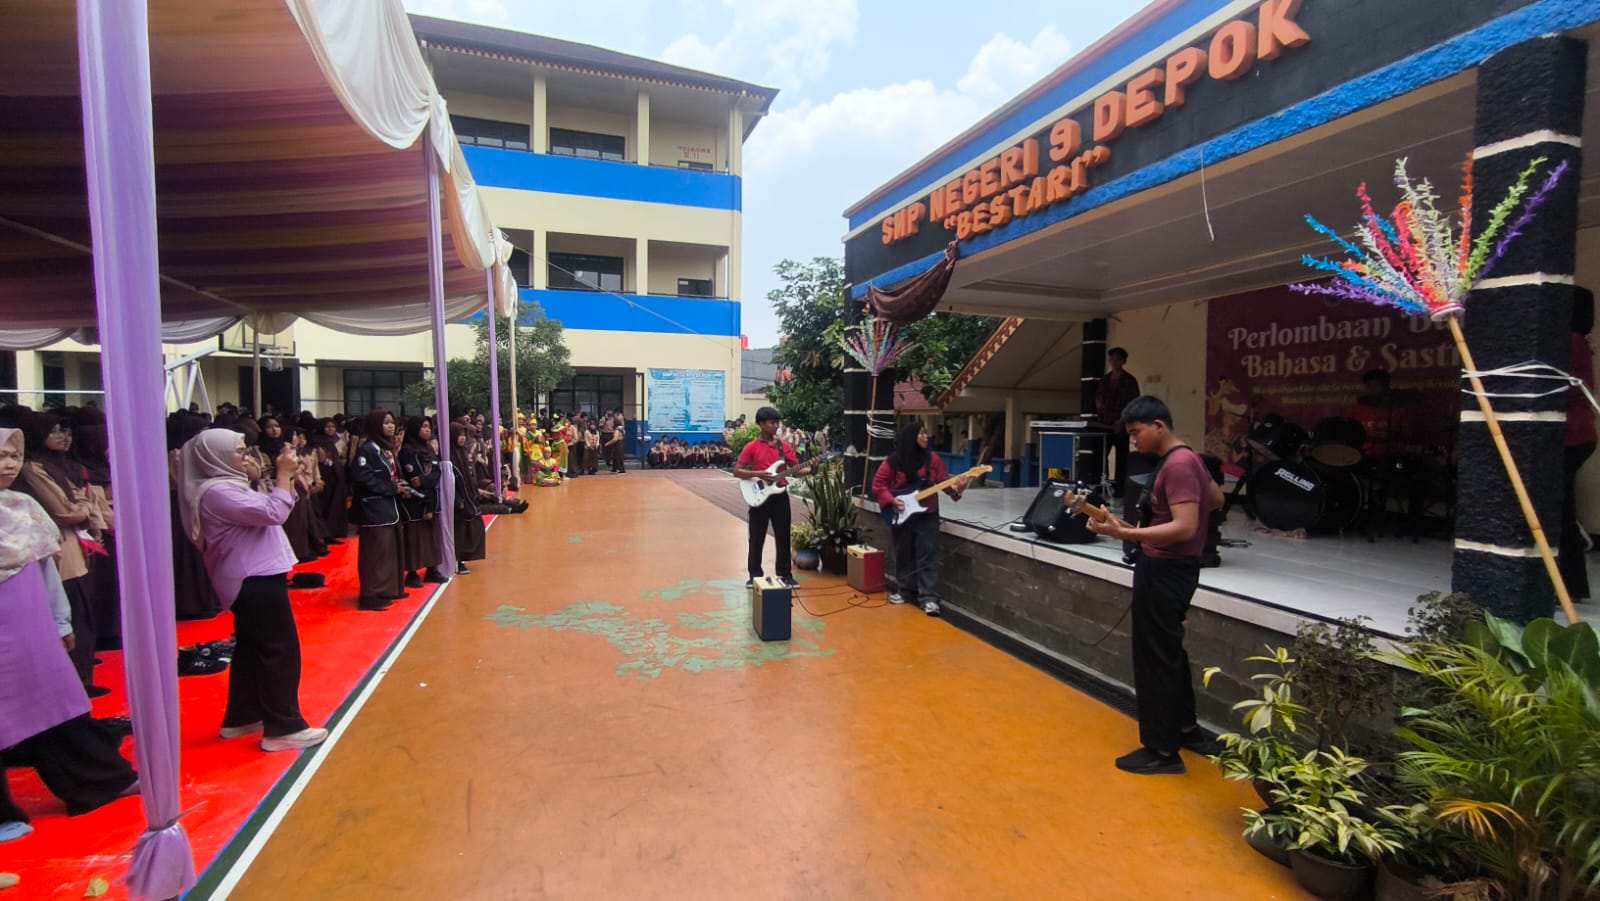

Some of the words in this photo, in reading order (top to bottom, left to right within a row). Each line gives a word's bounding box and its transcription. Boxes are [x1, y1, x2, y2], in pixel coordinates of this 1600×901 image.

[882, 202, 926, 245] SMP
[930, 138, 1039, 223] NEGERI
[1049, 118, 1081, 162] 9
[1093, 0, 1311, 142] DEPOK
[1228, 315, 1391, 350] Perlombaan
[1241, 351, 1337, 378] Bahasa
[1345, 345, 1371, 372] &
[1379, 343, 1461, 373] Sastr
